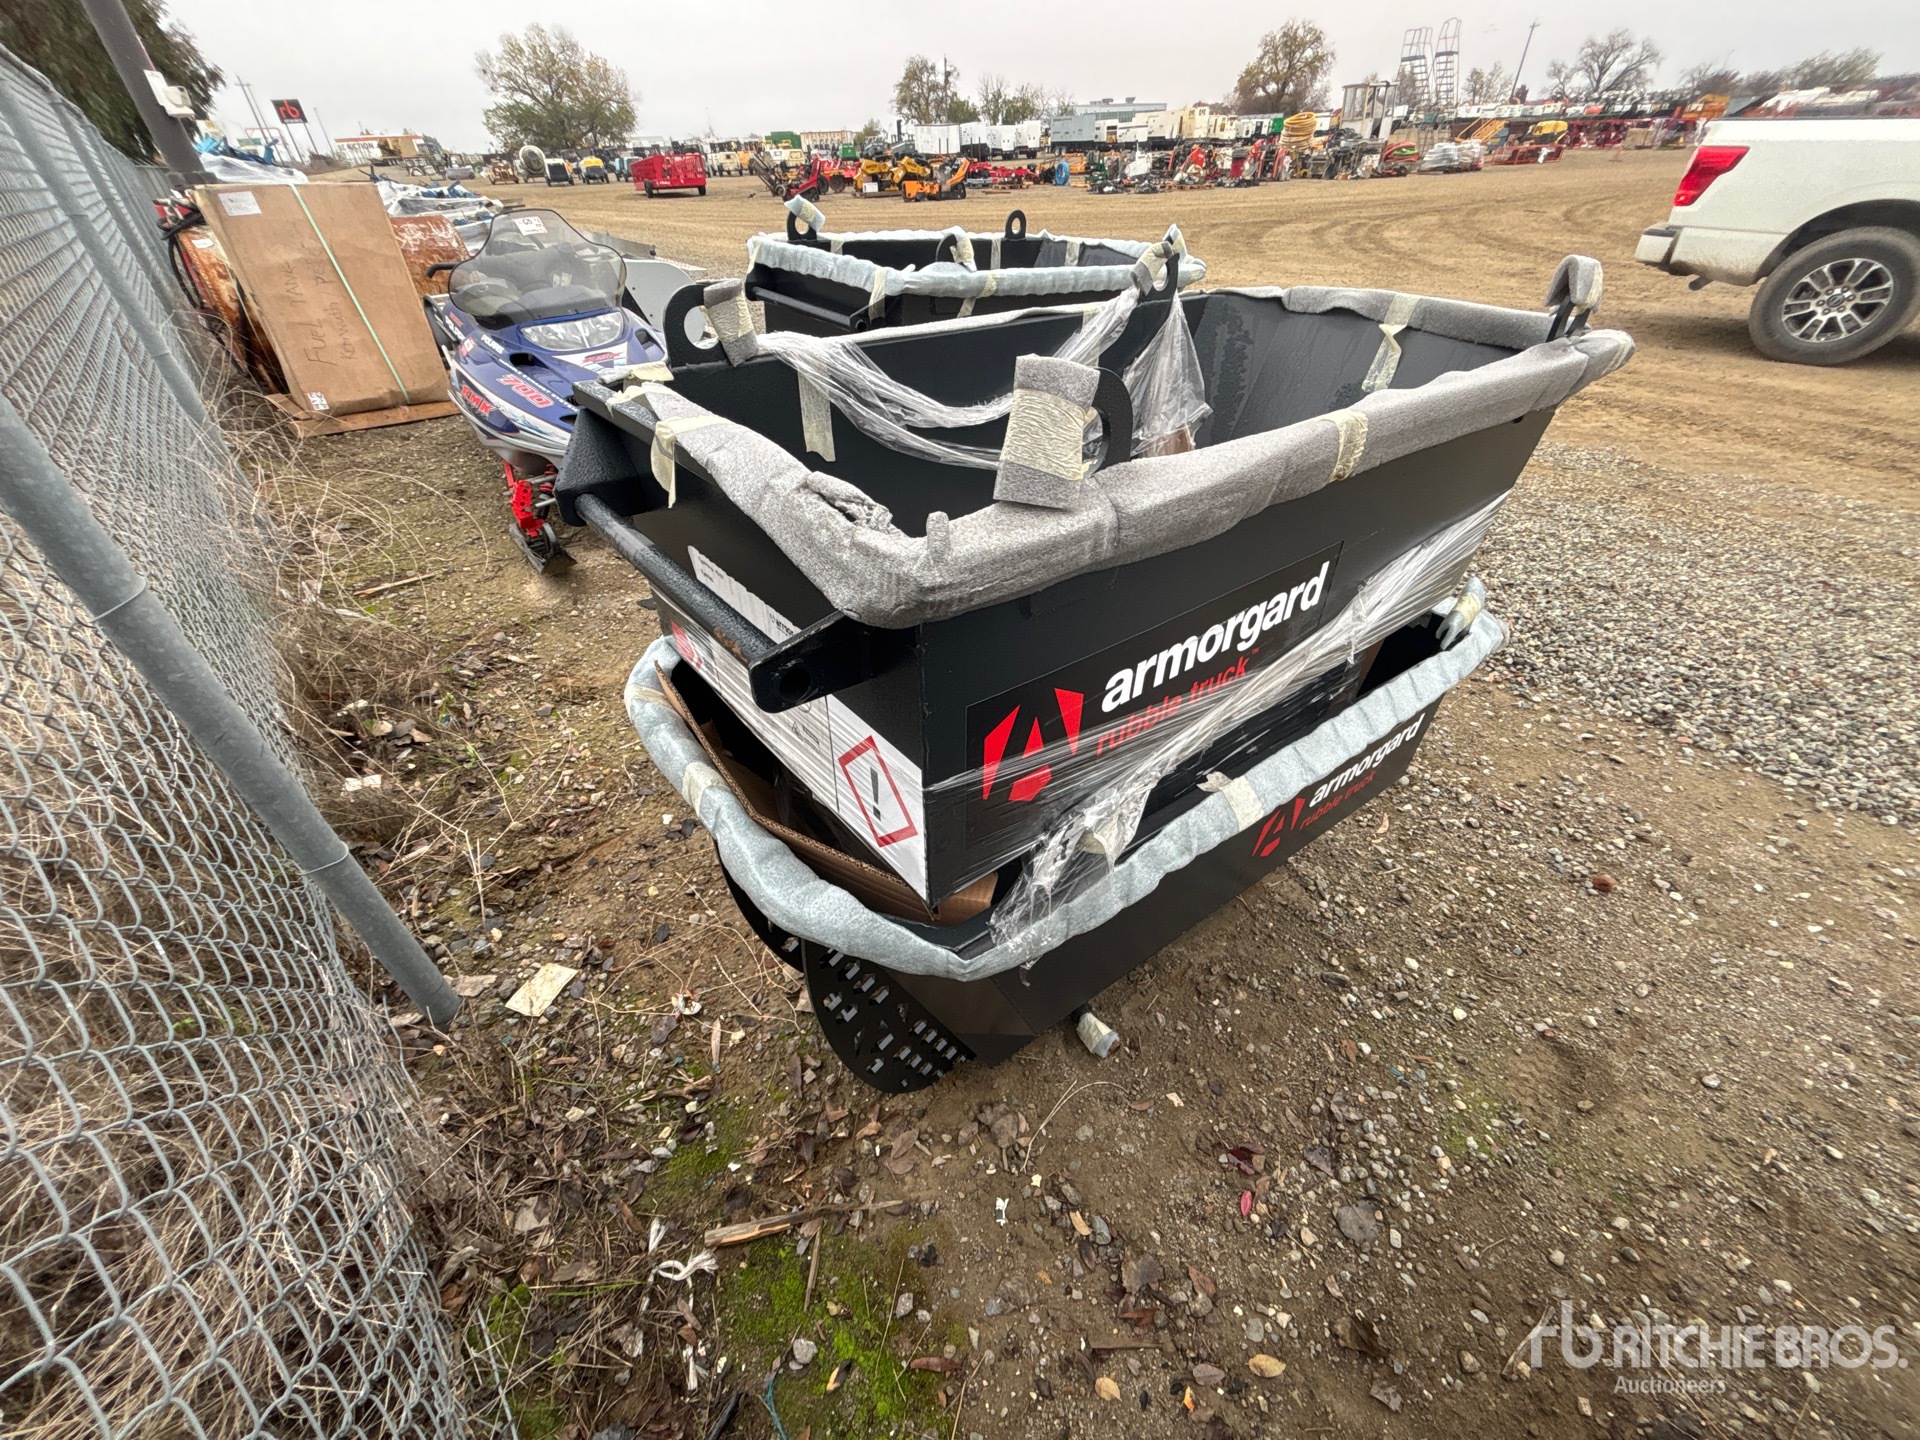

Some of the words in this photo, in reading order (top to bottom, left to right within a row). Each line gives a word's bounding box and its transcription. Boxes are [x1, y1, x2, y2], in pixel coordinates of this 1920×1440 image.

[279, 100, 300, 119] rb
[481, 334, 505, 355] POLARIS
[461, 384, 496, 415] RMK
[496, 373, 555, 409] 700
[1101, 560, 1331, 714] armorgard
[1096, 694, 1184, 757] rubble
[1308, 712, 1426, 808] armorgard
[1299, 793, 1343, 831] rubble
[1344, 769, 1377, 801] truck
